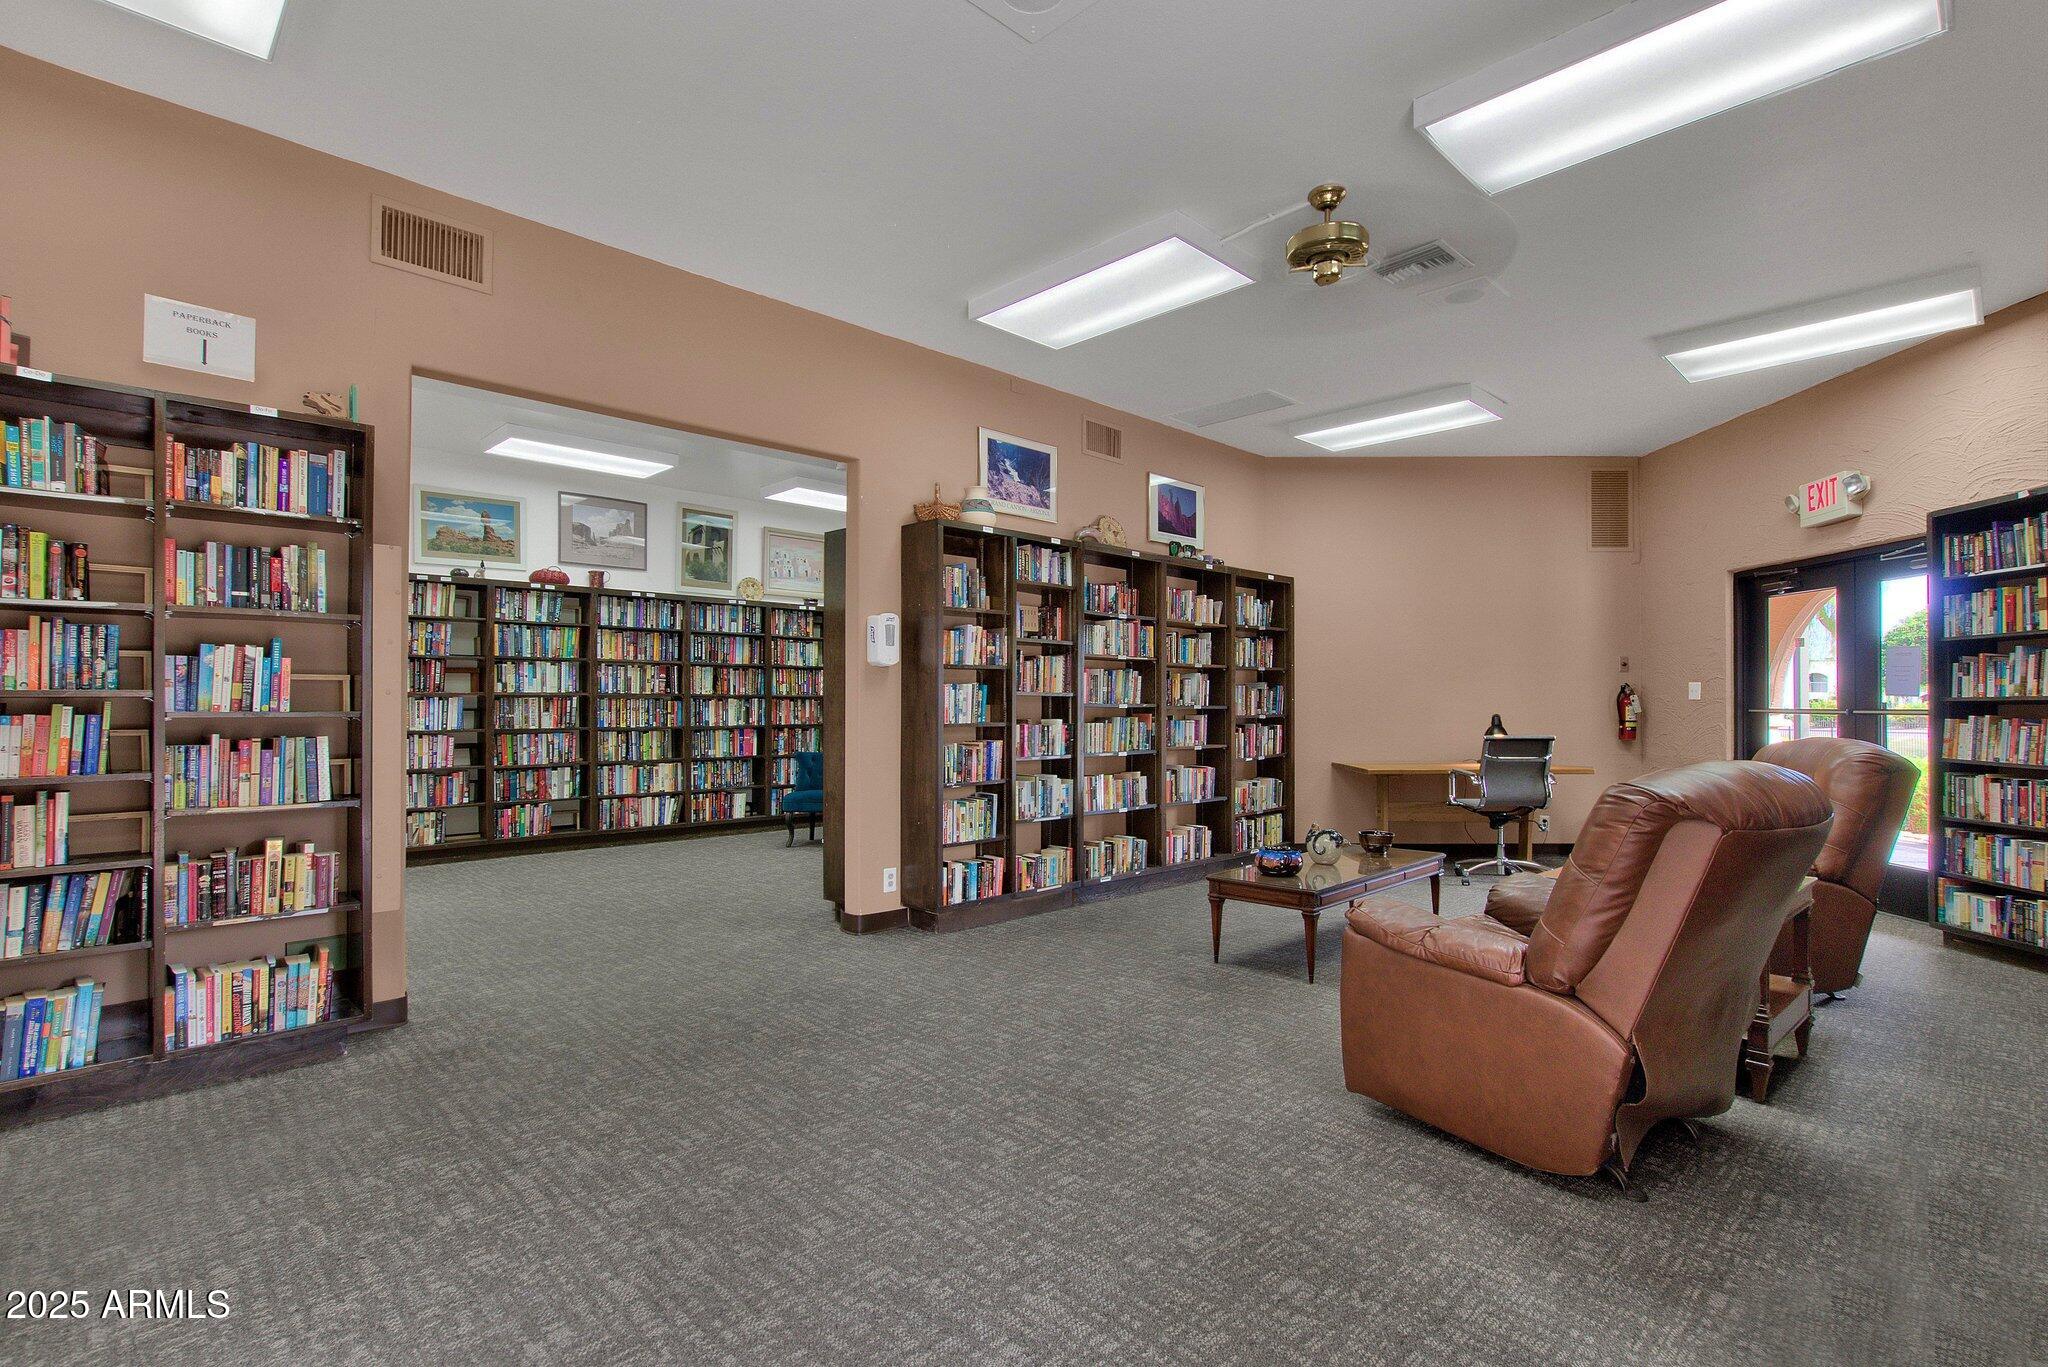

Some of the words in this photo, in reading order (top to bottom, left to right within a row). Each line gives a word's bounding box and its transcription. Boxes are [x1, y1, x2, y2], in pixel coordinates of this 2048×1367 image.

[172, 310, 232, 329] PAPERBACK
[185, 326, 219, 339] BOOKS
[10, 467, 18, 485] SHOT
[1807, 476, 1839, 512] EXIT
[83, 626, 91, 639] CLIVE
[83, 638, 91, 657] CUSSLER
[232, 993, 242, 1034] CORRECTIONS
